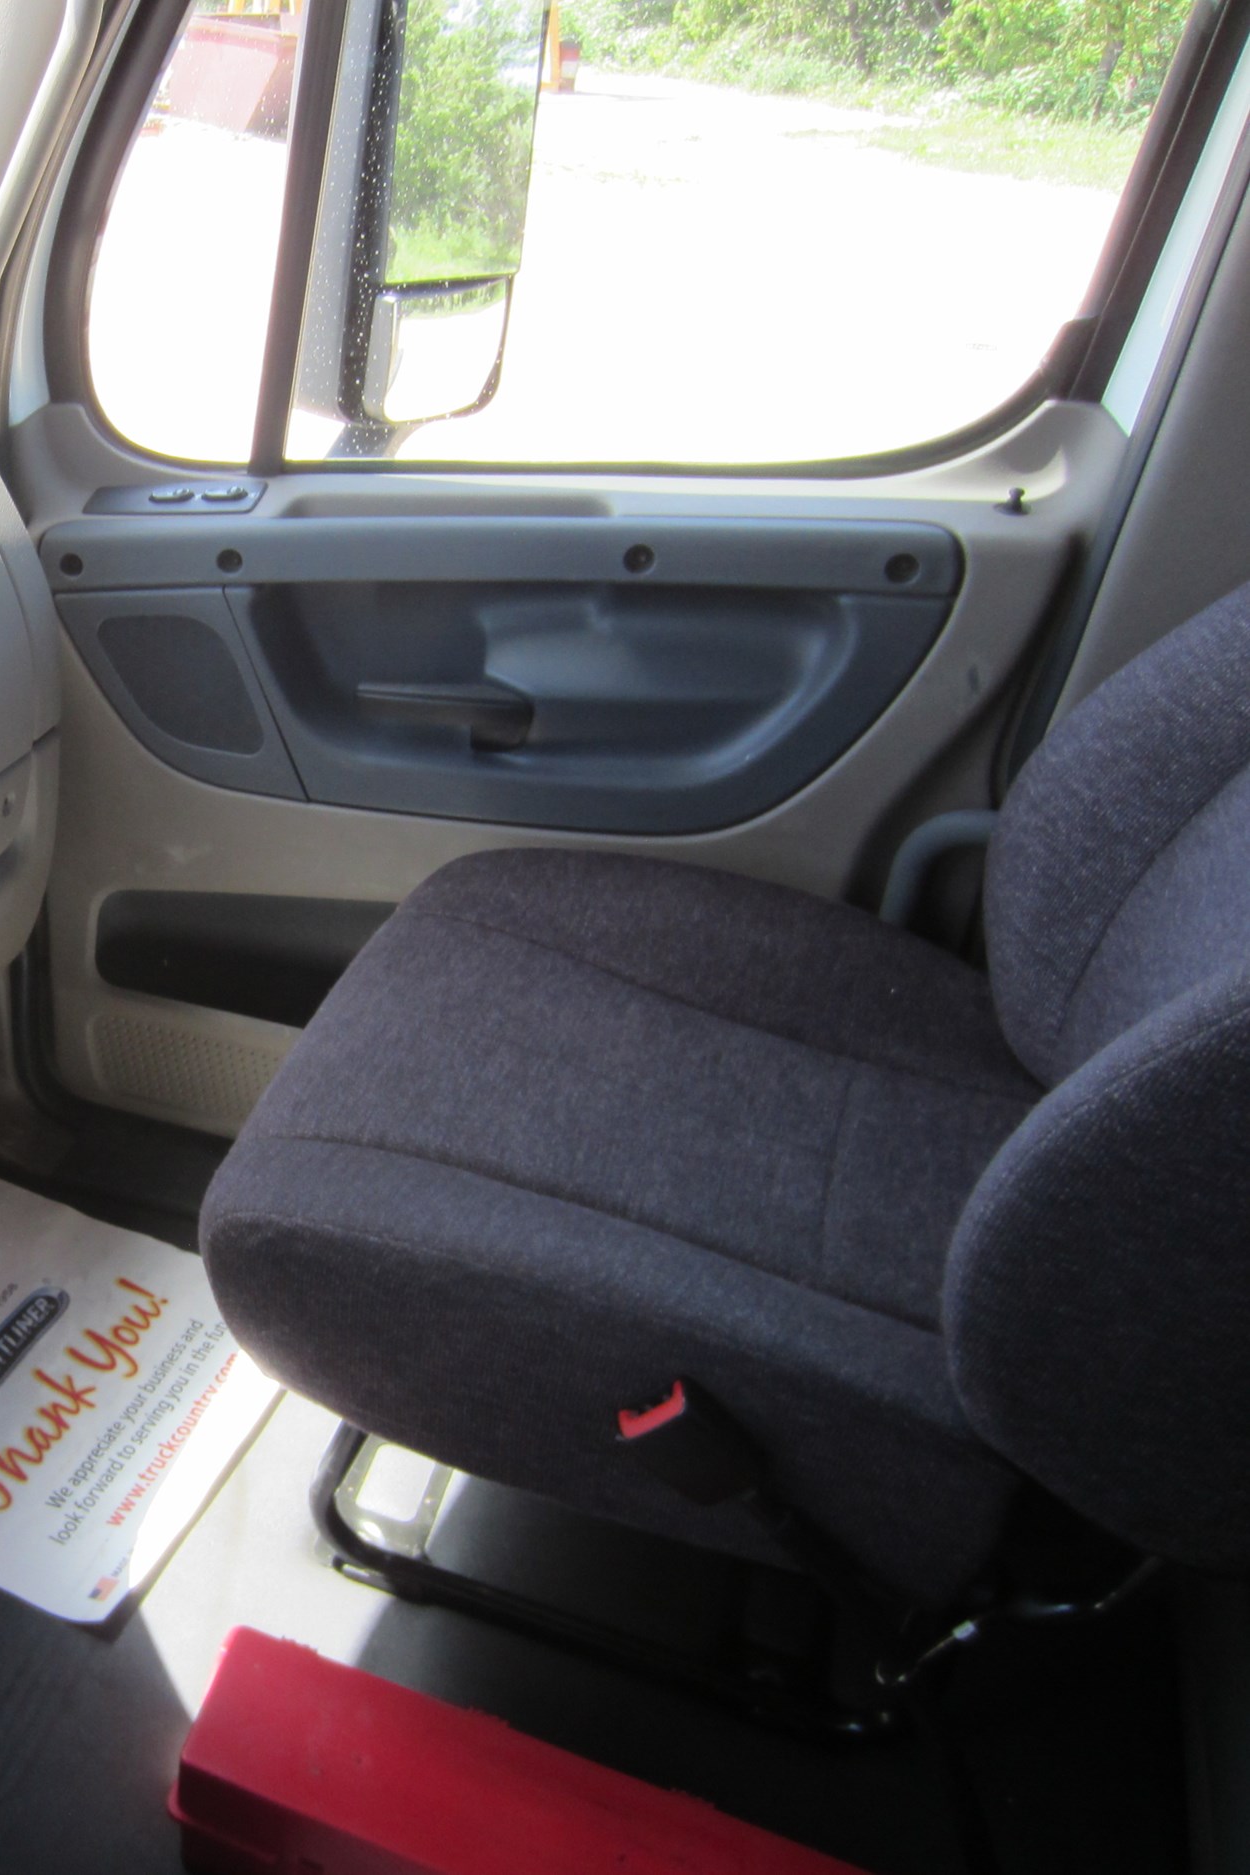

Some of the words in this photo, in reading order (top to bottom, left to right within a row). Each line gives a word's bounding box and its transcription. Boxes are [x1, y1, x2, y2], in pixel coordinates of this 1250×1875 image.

[45, 1487, 72, 1511] We
[68, 1420, 126, 1487] appreciate
[120, 1392, 147, 1424] your
[137, 1342, 187, 1396] business
[181, 1317, 204, 1346] and
[65, 1277, 168, 1380] You!
[49, 1512, 85, 1546] look
[74, 1458, 125, 1513] forward
[117, 1444, 136, 1462] to
[131, 1400, 176, 1446] serving
[165, 1374, 190, 1402] you
[184, 1361, 198, 1377] in
[192, 1340, 215, 1363] the
[106, 1352, 238, 1527] www.truckcountry.com
